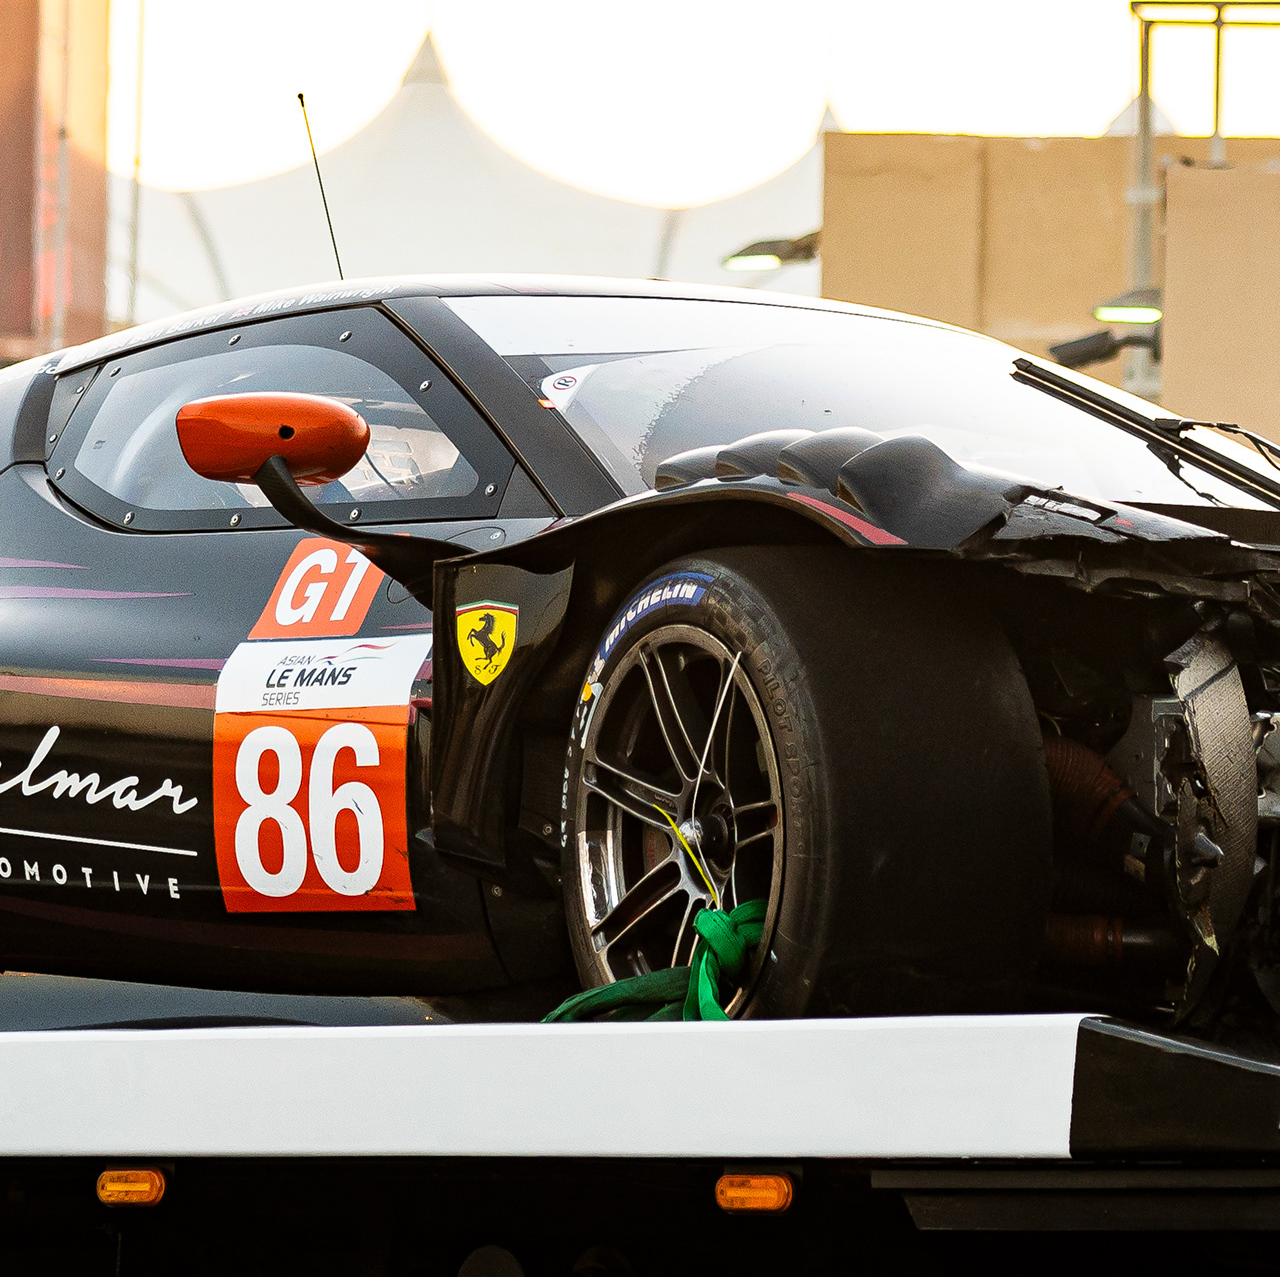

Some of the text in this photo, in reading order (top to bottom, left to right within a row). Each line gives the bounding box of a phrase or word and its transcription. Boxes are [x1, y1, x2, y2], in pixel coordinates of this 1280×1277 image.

[252, 285, 401, 316] Mike Wainwright
[605, 583, 698, 653] MICHELIN
[277, 655, 315, 666] ASIAN
[265, 667, 357, 689] LE MANS
[261, 692, 300, 706] SERIES
[756, 658, 794, 732] PILOT
[235, 723, 384, 897] 86
